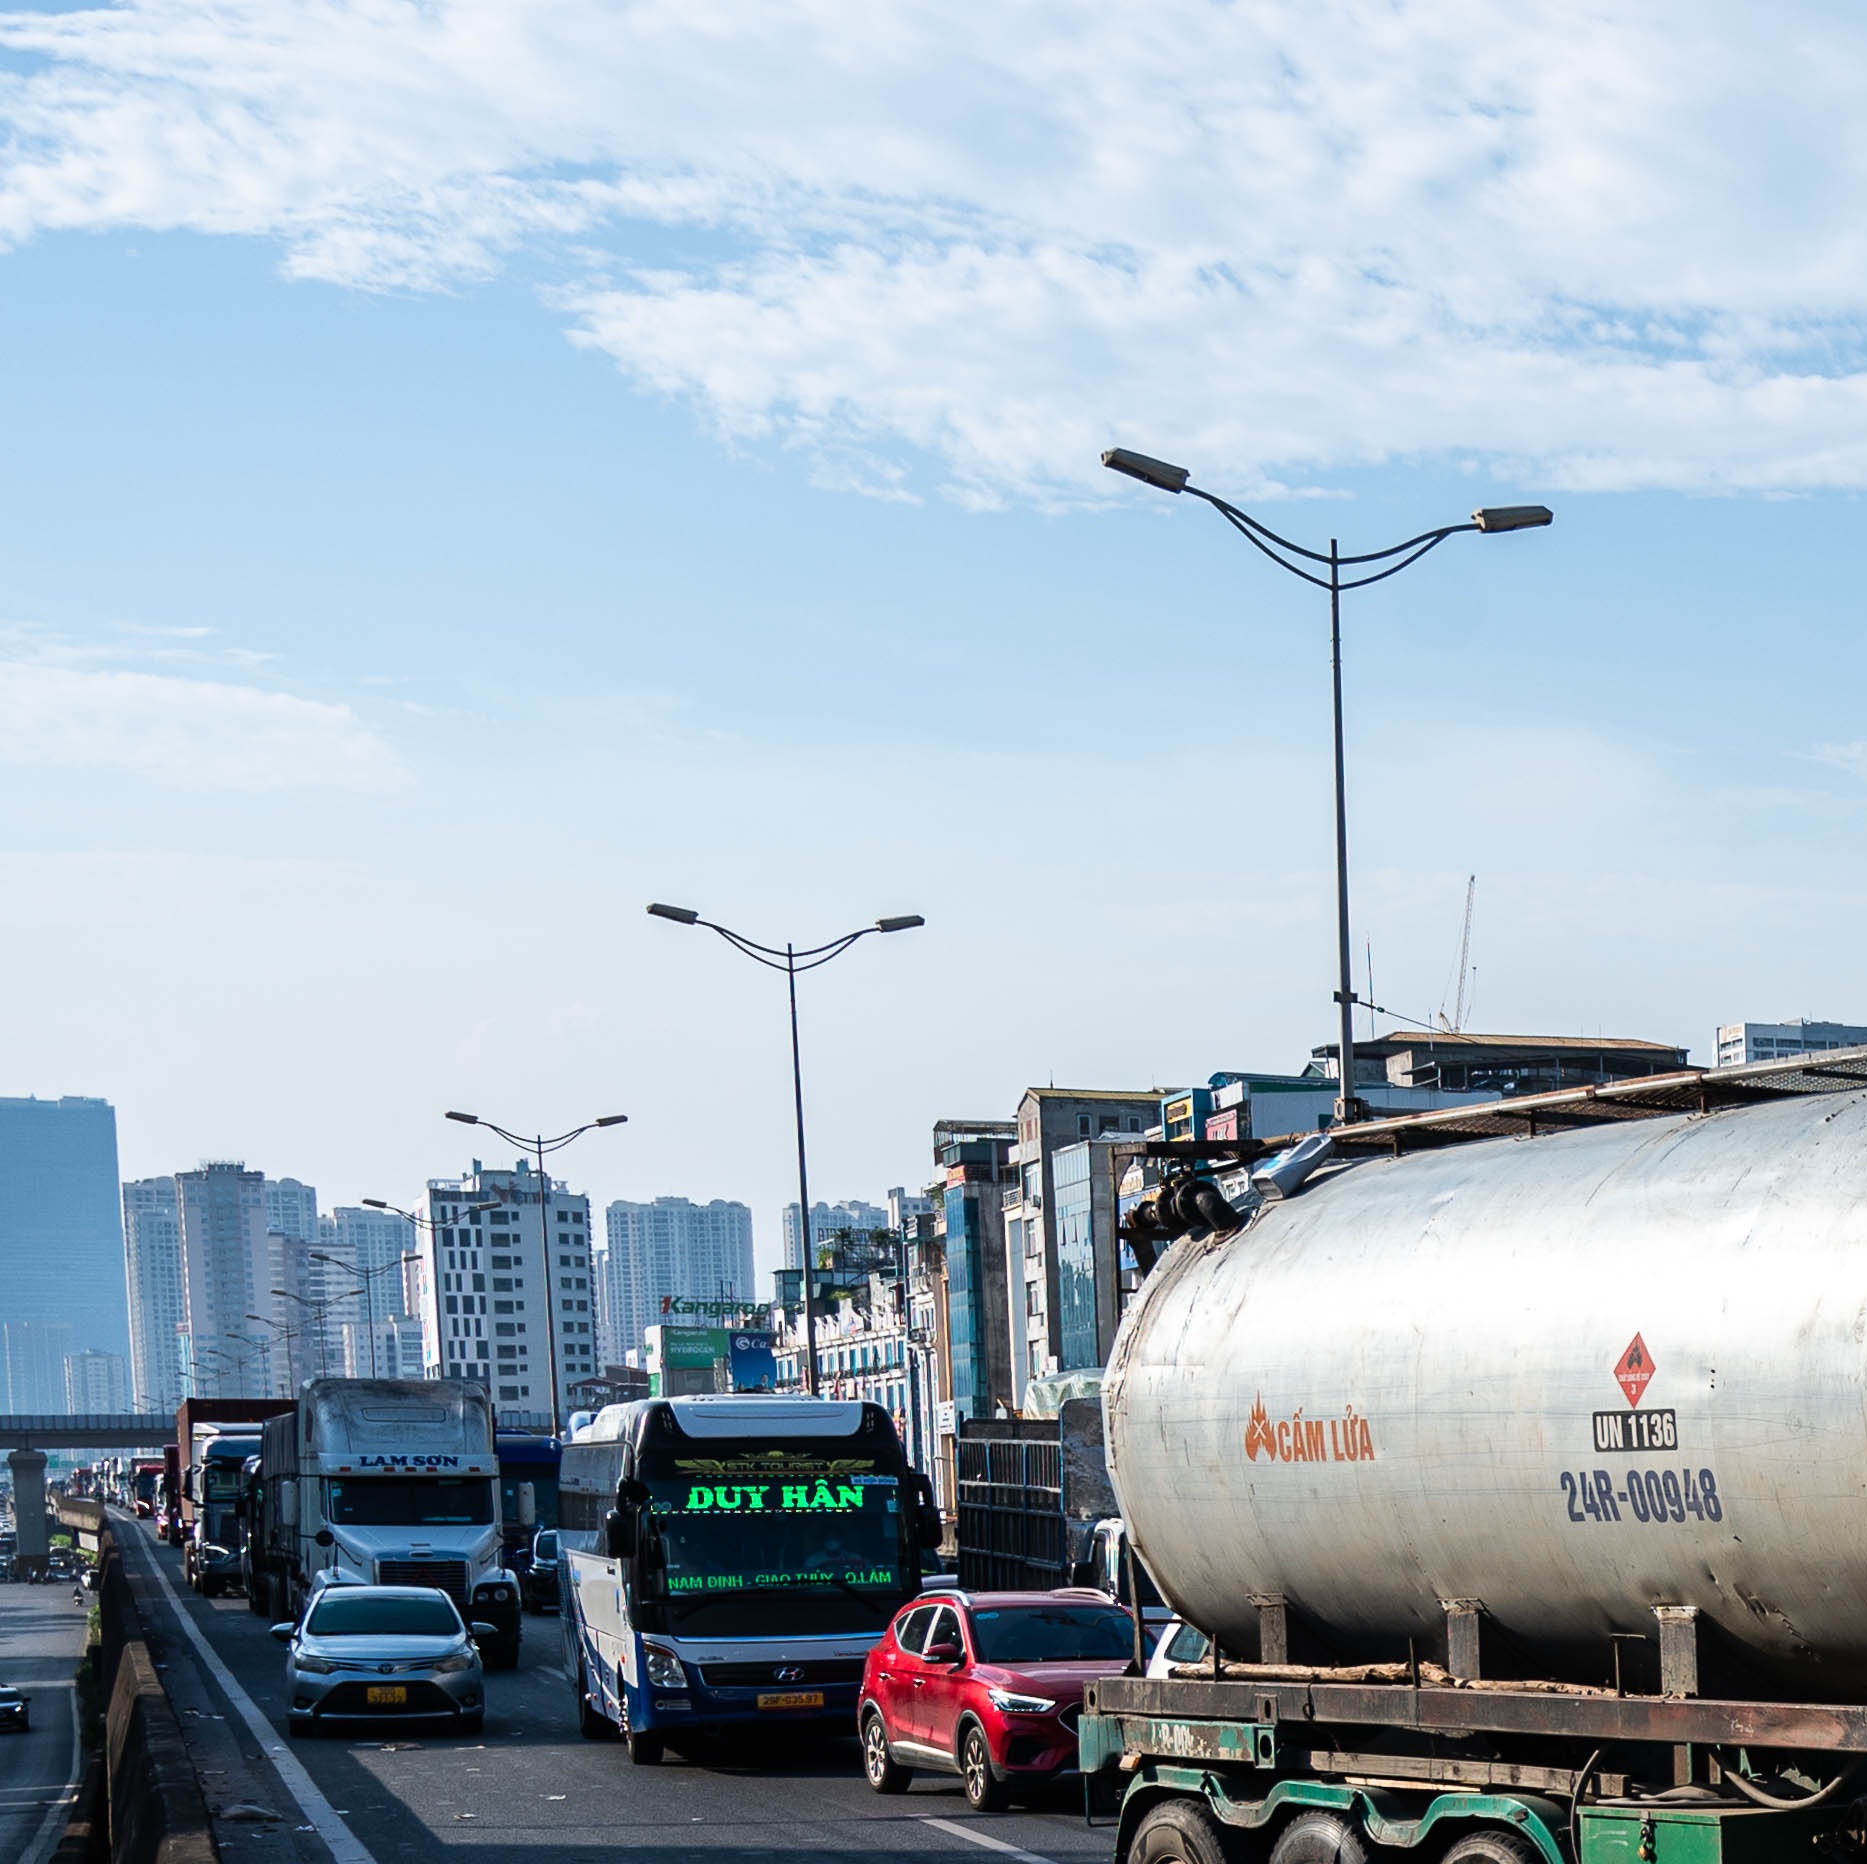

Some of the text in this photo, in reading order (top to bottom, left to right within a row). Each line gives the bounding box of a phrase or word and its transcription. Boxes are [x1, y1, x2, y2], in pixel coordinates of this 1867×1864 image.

[1631, 1384, 1637, 1395] 3
[1278, 1404, 1375, 1463] CẤM LỬA
[1596, 1412, 1676, 1449] UN 1136
[686, 1479, 864, 1509] DUY HÂN
[1560, 1468, 1723, 1523] 24R-00948
[668, 1577, 703, 1589] NAM
[707, 1575, 743, 1589] ĐỊNH
